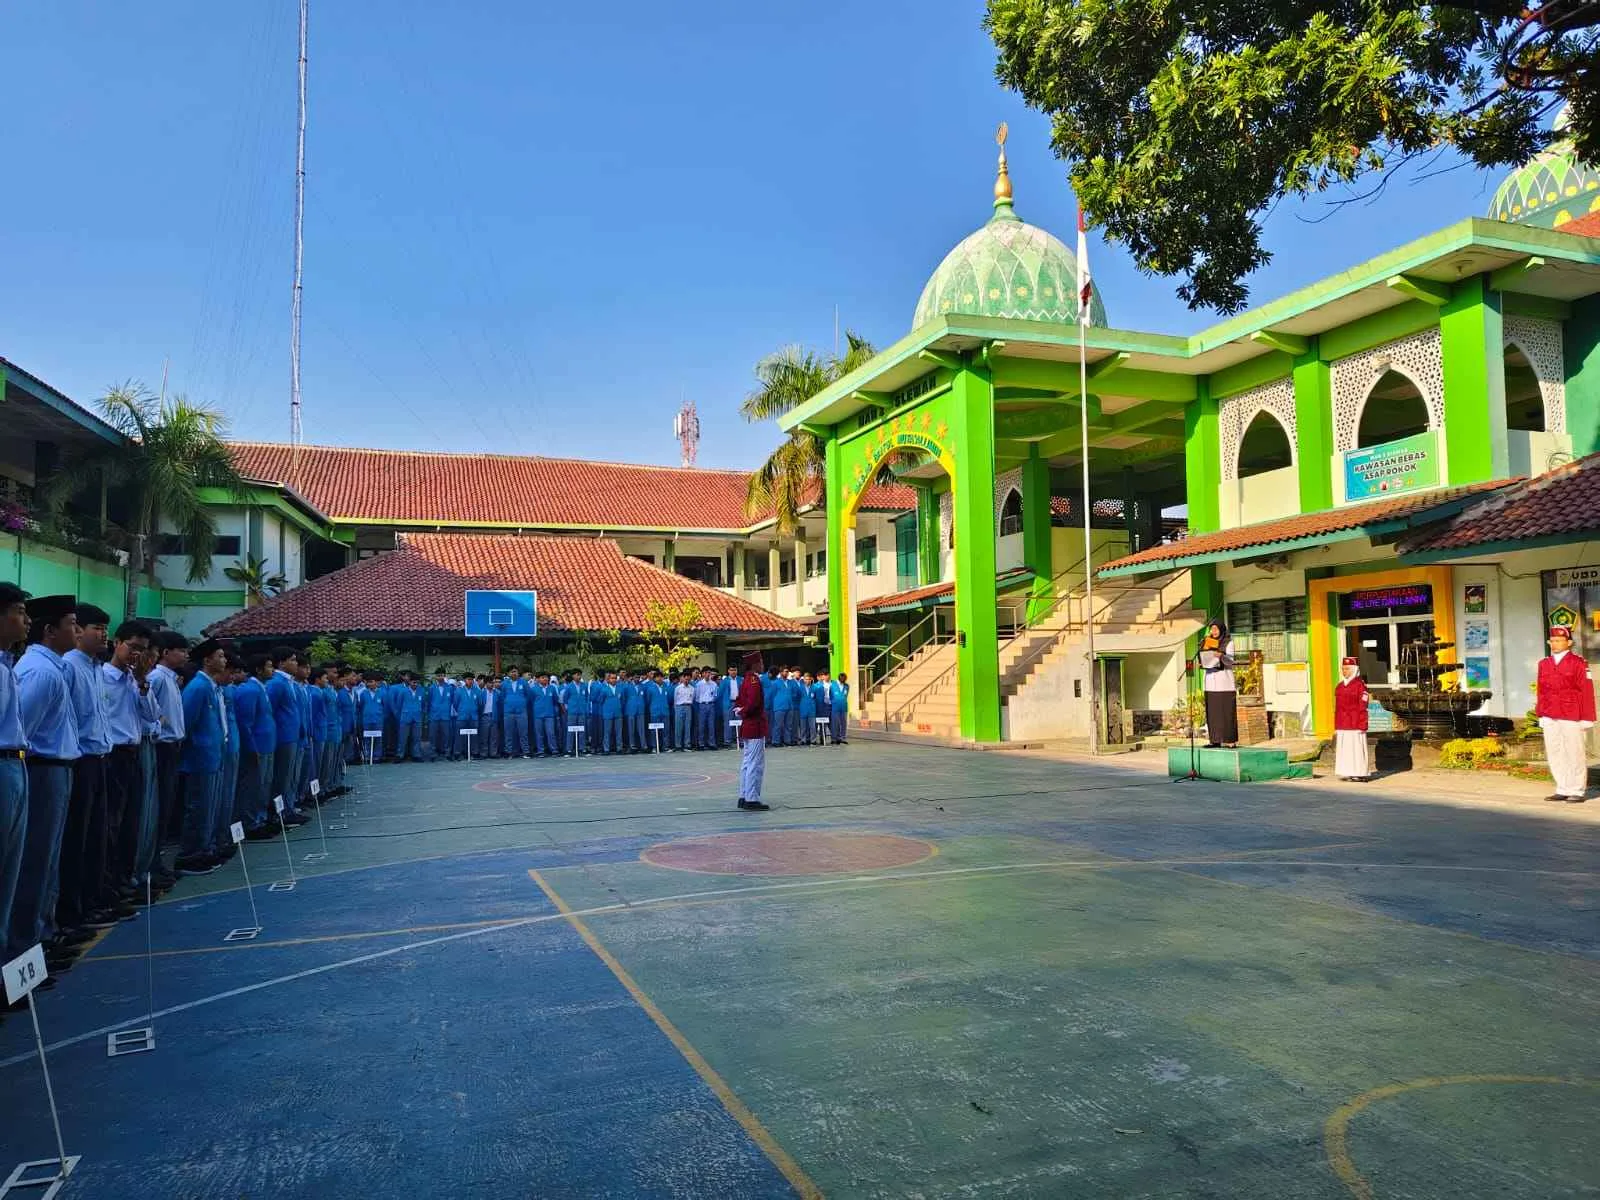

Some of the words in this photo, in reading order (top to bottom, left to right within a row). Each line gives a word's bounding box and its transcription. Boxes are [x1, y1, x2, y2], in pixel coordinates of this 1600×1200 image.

[1354, 457, 1396, 473] KAWASAN
[1398, 451, 1426, 464] BEBAS
[1364, 469, 1386, 481] ASAP
[1386, 462, 1417, 476] ROKOK
